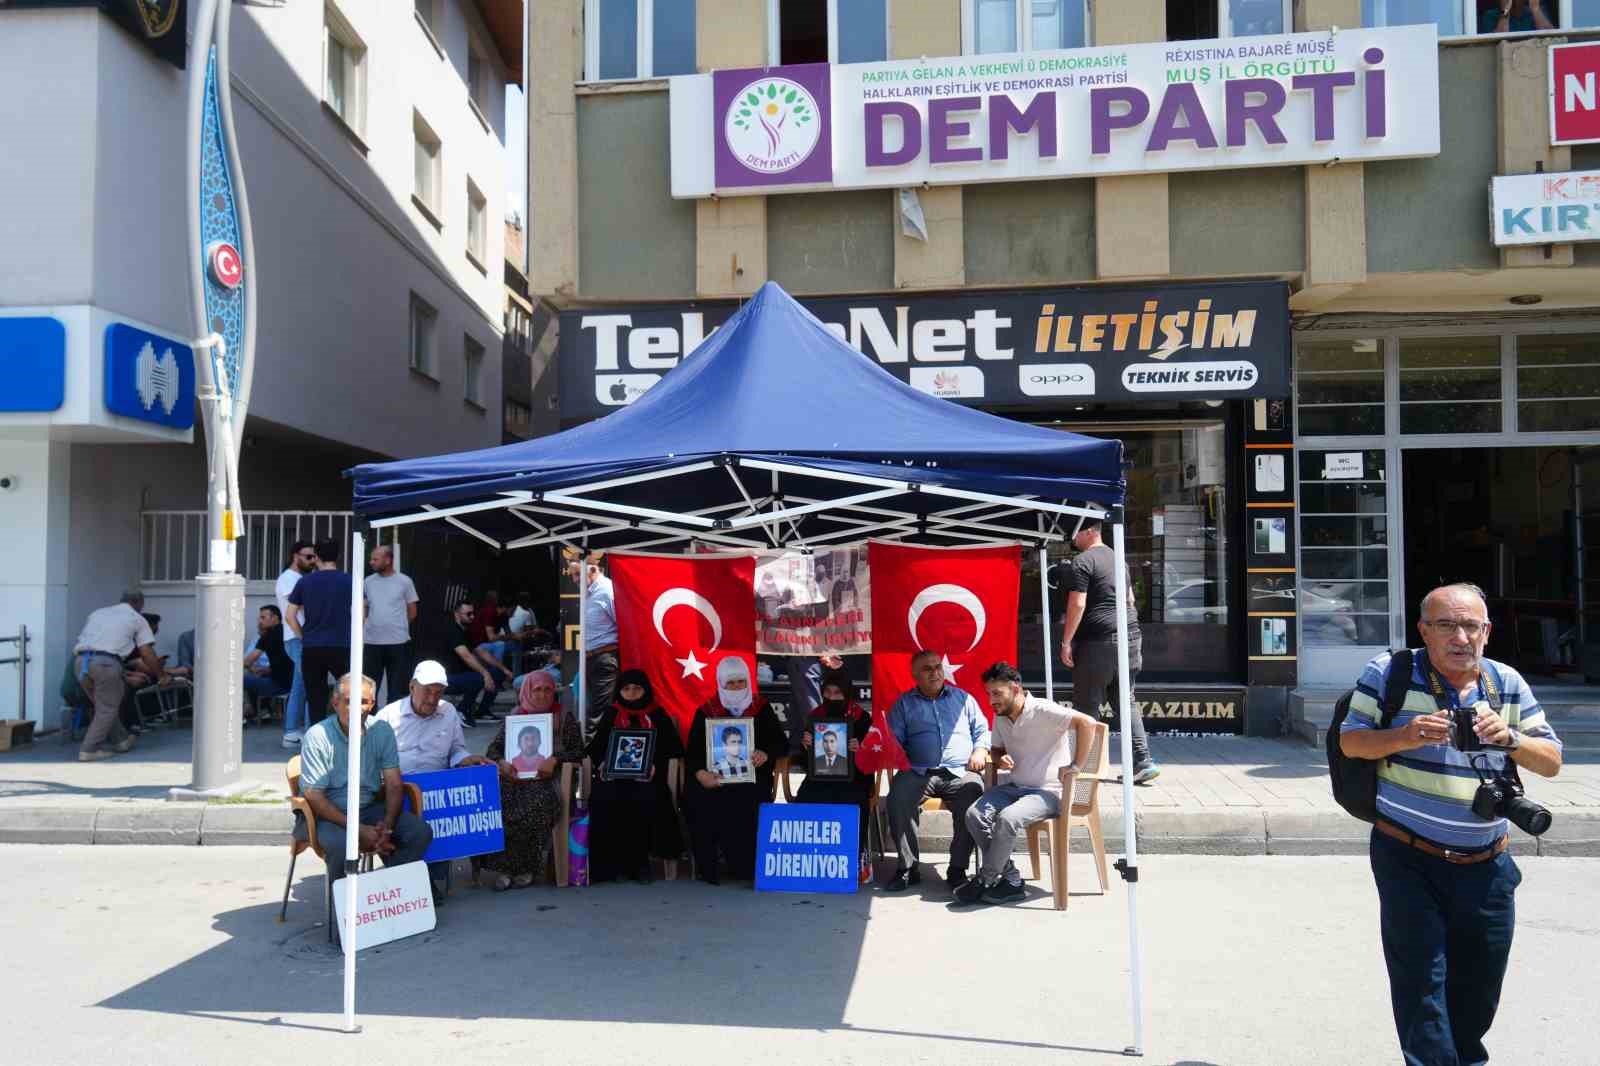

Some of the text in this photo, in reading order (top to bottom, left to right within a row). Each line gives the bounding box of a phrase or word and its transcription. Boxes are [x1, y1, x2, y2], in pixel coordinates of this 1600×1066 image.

[912, 67, 953, 80] GELAN
[958, 66, 967, 77] A
[1166, 56, 1336, 84] MUŞ İL ÖRGÜTÜ
[863, 70, 1128, 99] HALKLARIN EŞİTLİK VE DEMOKRASİ PARTİSİ
[1564, 72, 1600, 112] N
[863, 47, 1386, 168] DEM PARTİ
[745, 152, 768, 168] DEM
[1503, 203, 1600, 236] KIR
[1034, 299, 1257, 360] İLETİŞİM
[1126, 364, 1254, 385] TEKNİK SERVİS
[422, 789, 446, 811] RTIK
[447, 785, 478, 807] YETER
[764, 819, 849, 879] ANNELER DİRENİYOR
[367, 888, 402, 905] EVLAT
